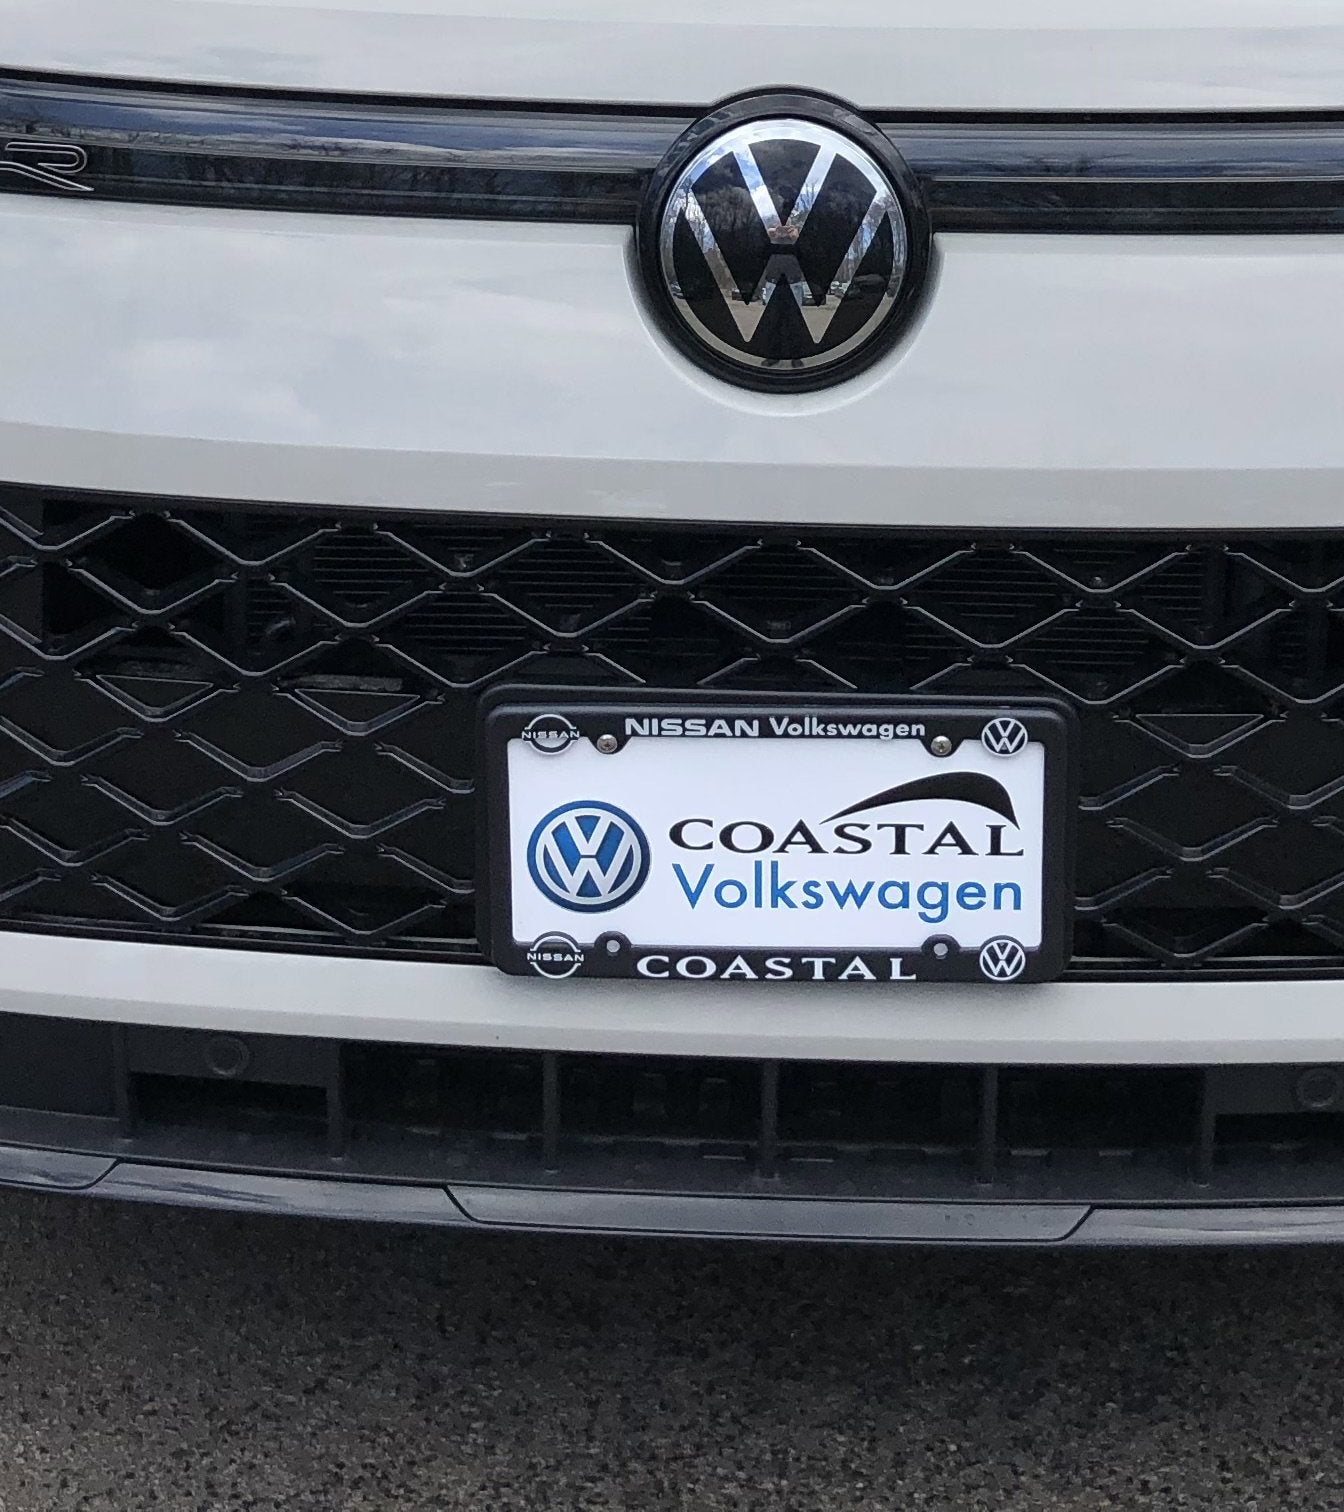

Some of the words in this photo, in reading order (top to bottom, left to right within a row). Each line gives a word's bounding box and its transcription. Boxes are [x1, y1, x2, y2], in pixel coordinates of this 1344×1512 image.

[521, 730, 581, 740] NISSAN
[624, 717, 760, 737] NISSAN
[769, 715, 926, 740] Volkswagen
[668, 818, 1024, 857] COASTAL
[671, 860, 1022, 924] Volkswagen
[526, 951, 585, 962] NISSAN
[636, 954, 917, 981] COASTAL
